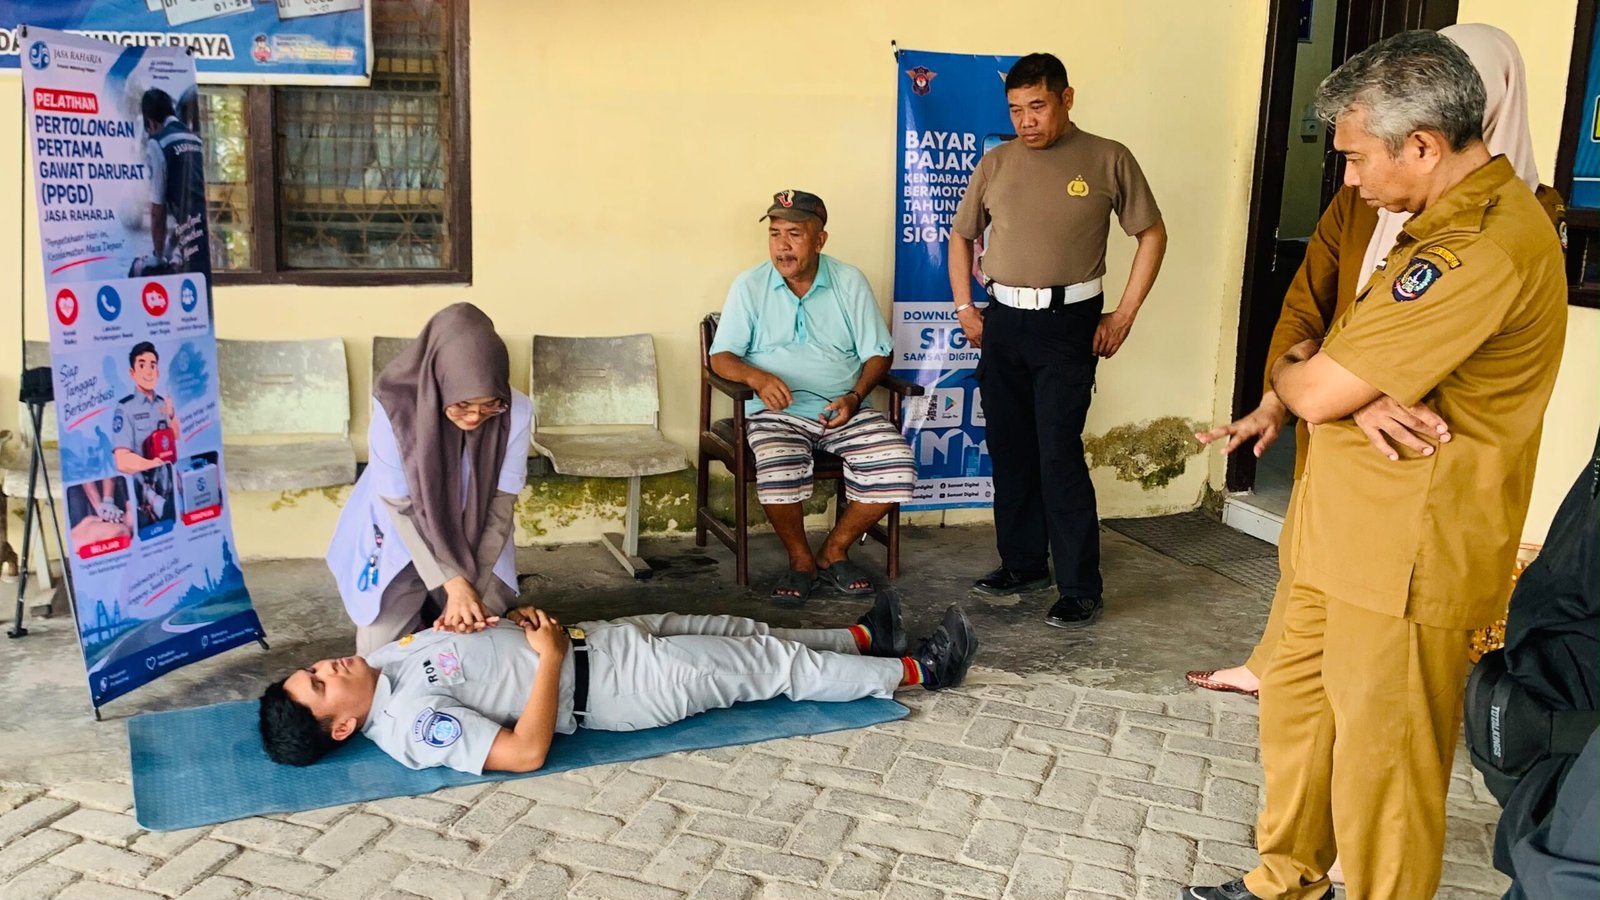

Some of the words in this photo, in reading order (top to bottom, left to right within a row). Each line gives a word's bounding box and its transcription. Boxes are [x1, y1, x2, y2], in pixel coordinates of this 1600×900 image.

[53, 49, 68, 60] JASA
[70, 51, 102, 64] RAHARJA
[34, 92, 97, 110] PELATIHAN
[35, 115, 136, 138] PERTOLONGAN
[37, 138, 104, 158] PERTAMA
[905, 130, 976, 151] BAYAR
[904, 150, 976, 171] PAJAK
[40, 161, 85, 179] GAWAT
[88, 162, 144, 180] DARURAT
[904, 173, 970, 184] KENDARAA
[42, 182, 94, 206] (PPGD)
[903, 185, 966, 197] BERMOTO
[904, 199, 959, 212] TAHUN
[44, 209, 68, 222] JASA
[70, 209, 115, 221] RAHARJA
[903, 213, 916, 225] DI
[920, 213, 953, 225] APLI
[902, 226, 952, 243] SIGN
[903, 311, 958, 320] DOWNLO
[920, 327, 972, 349] SIG
[903, 352, 944, 361] SAMSAT
[949, 352, 979, 361] DIGITA
[60, 364, 78, 382] Siap
[64, 376, 97, 400] Tanggap
